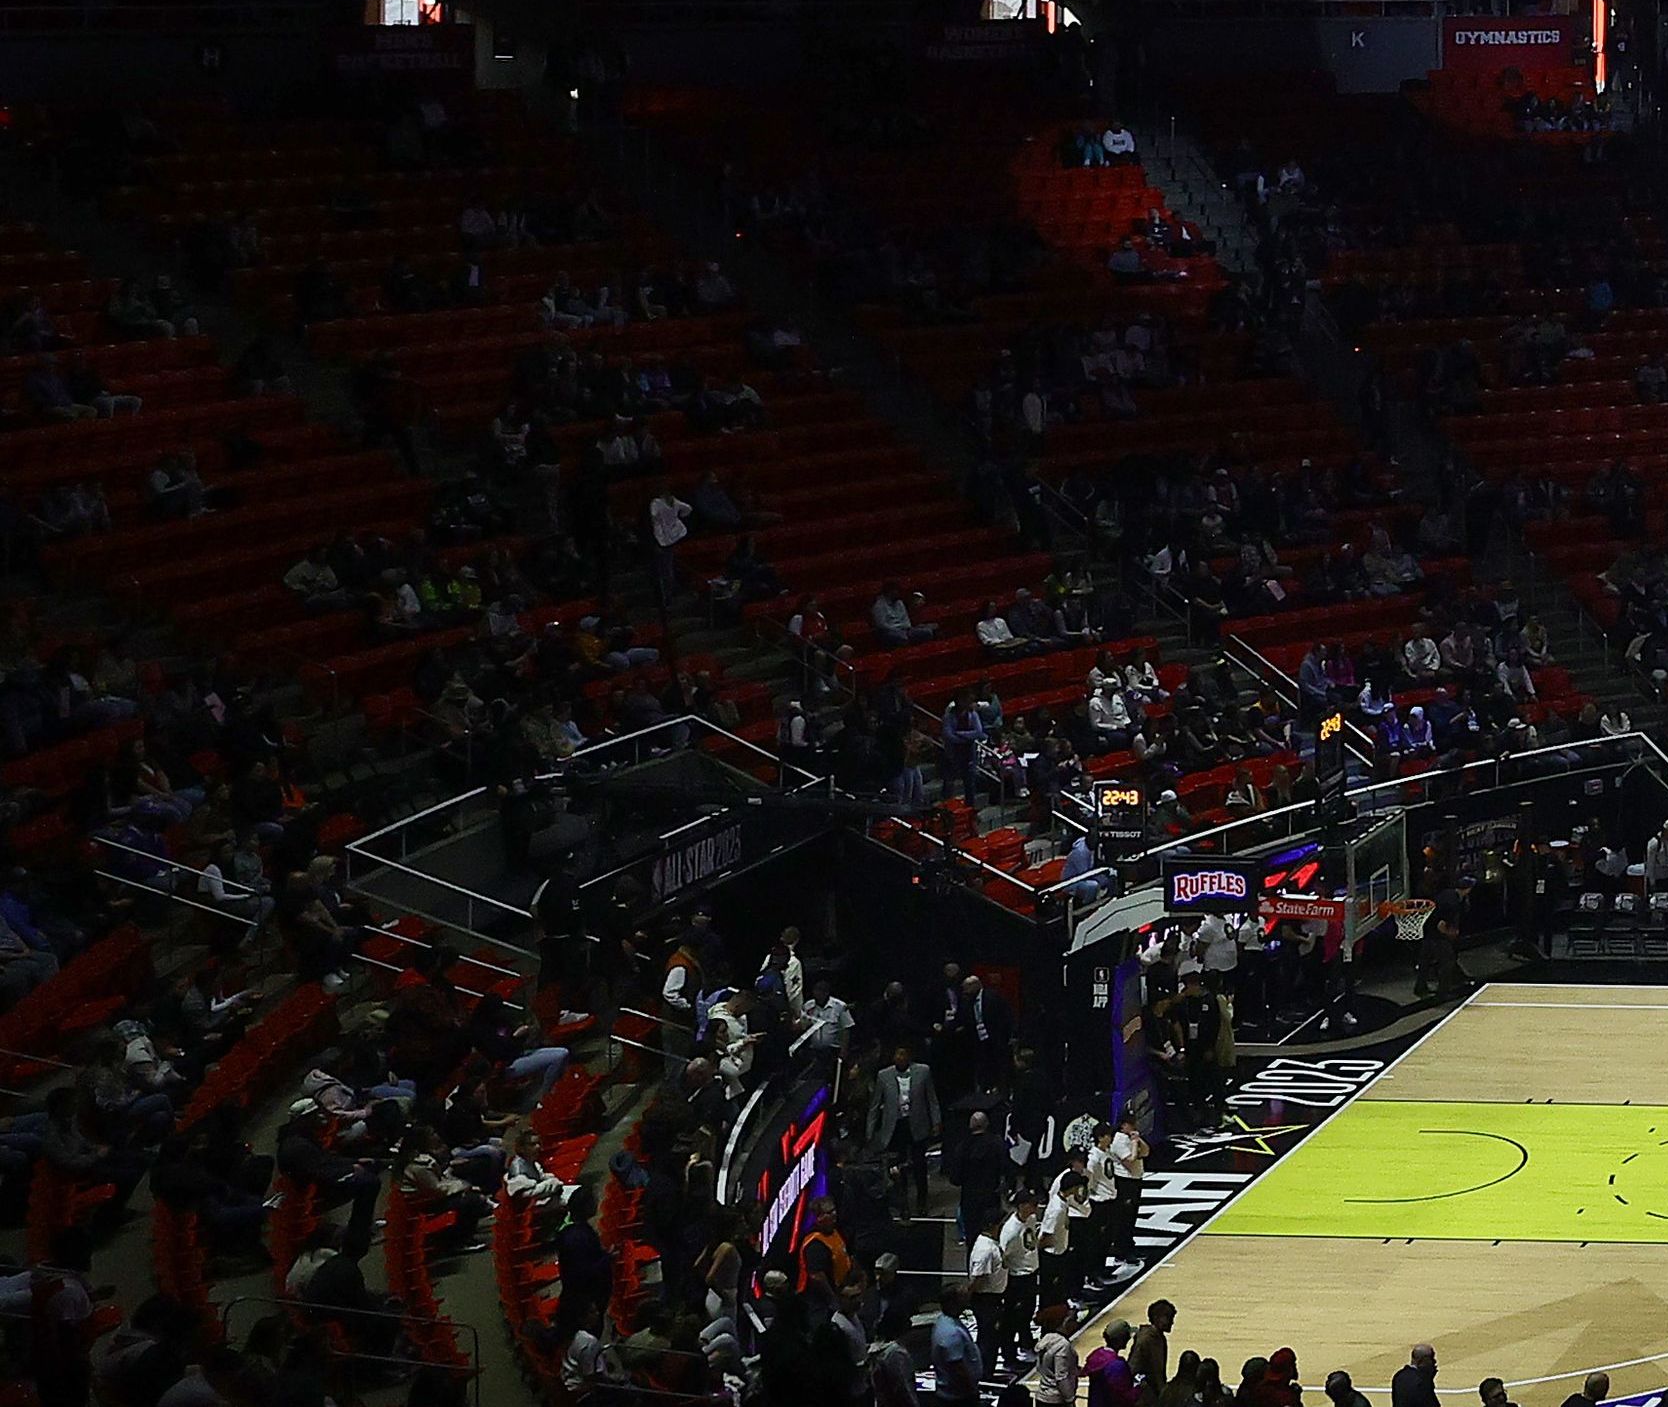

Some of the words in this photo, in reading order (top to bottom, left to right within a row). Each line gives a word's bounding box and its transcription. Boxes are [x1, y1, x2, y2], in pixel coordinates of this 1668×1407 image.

[1351, 31, 1366, 48] K
[1102, 790, 1139, 806] 22:43
[1110, 831, 1141, 839] TISSOT
[1175, 871, 1246, 900] RUFFLES
[1225, 1058, 1385, 1107] 2023
